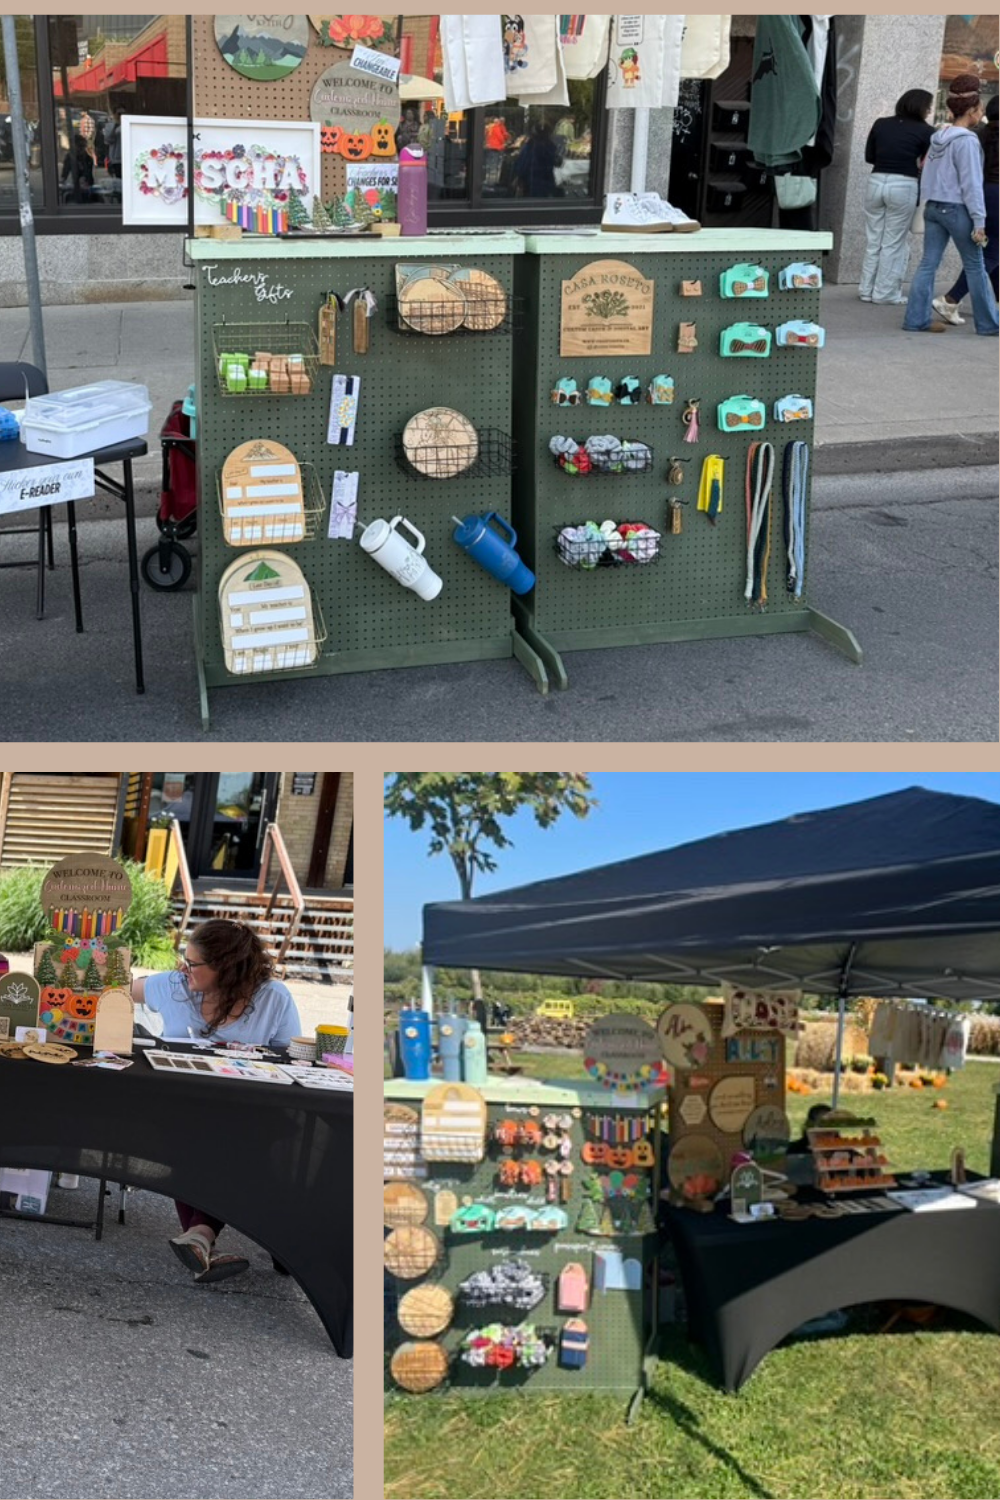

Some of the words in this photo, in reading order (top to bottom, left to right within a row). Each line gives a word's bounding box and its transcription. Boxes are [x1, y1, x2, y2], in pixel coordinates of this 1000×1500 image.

[353, 57, 397, 80] CHANGEABLE
[321, 77, 376, 89] WELCOME
[379, 83, 393, 95] TO
[330, 106, 382, 118] CLASSROOM
[348, 176, 377, 187] CHANGES
[378, 176, 390, 187] FOR
[563, 276, 596, 295] CASA
[600, 274, 651, 295] ROSETO
[19, 482, 62, 500] E-READER
[52, 868, 106, 879] WELCOME
[109, 870, 124, 881] TO
[60, 893, 111, 903] CLASSROOM
